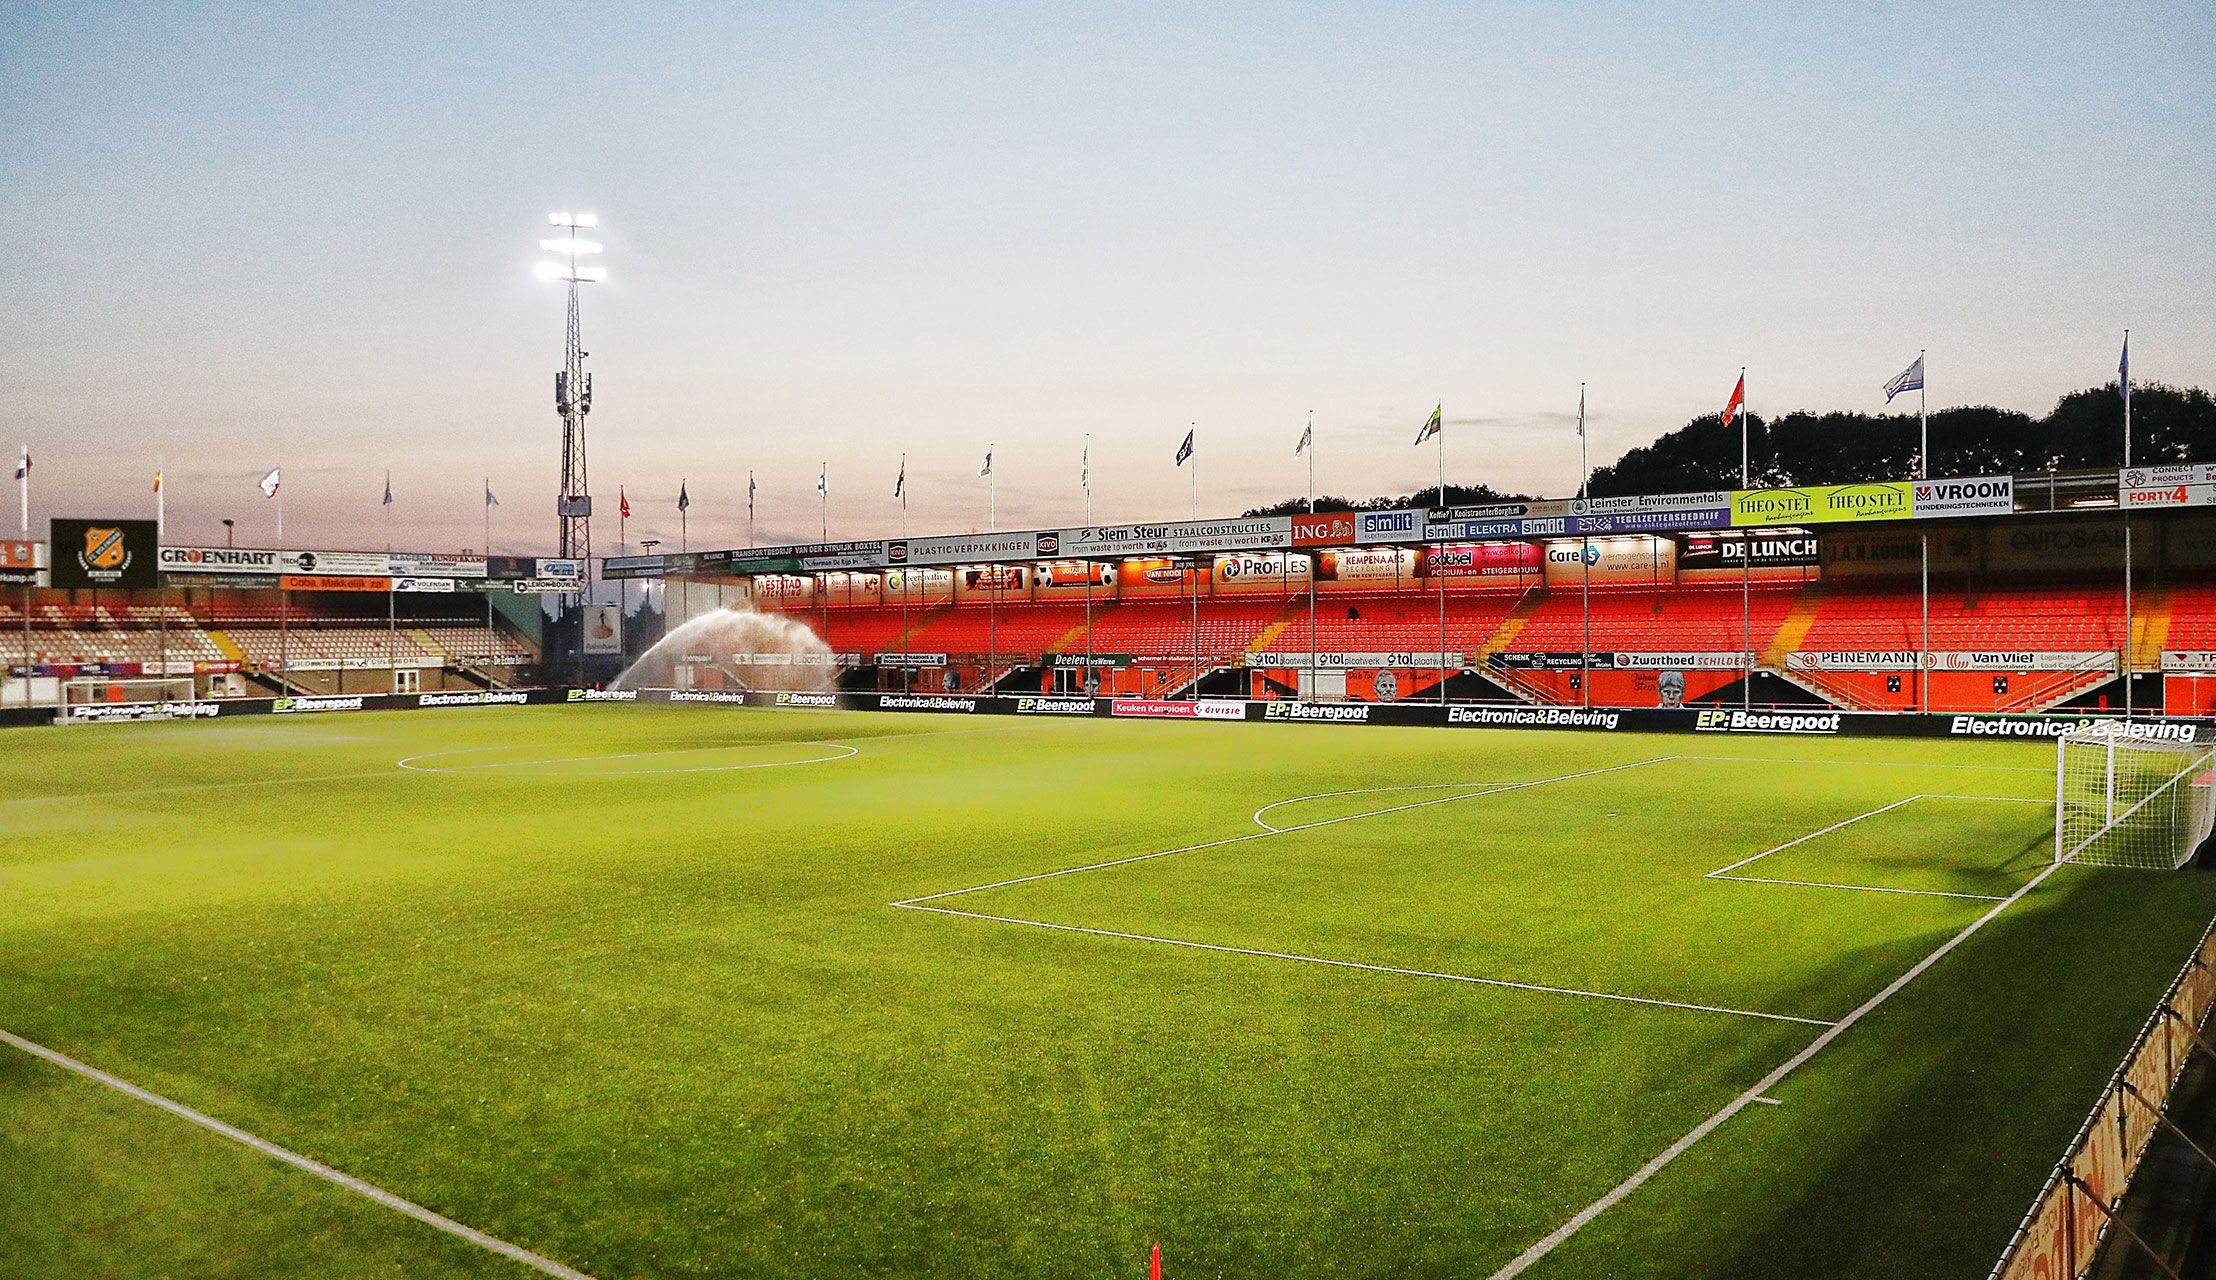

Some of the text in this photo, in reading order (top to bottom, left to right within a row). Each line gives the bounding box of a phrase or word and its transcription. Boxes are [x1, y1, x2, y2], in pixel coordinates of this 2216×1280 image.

[2152, 465, 2194, 474] CONNECT
[2152, 474, 2194, 482] PRODUCTS
[1936, 481, 2009, 500] VROOM
[1590, 492, 1724, 510] Leinster Environmentals
[1738, 498, 1812, 514] THEO STET
[1828, 492, 1905, 510] THEO STET
[1915, 500, 2010, 512] FUNDERINGSTECHNIEKEN
[1428, 508, 1450, 520] Koffie?
[1616, 511, 1720, 524] TEGELZETTERSBEDRIJF
[1366, 514, 1412, 532] smit
[1470, 524, 1518, 535] ELEKTRA
[1523, 518, 1566, 534] smit
[1098, 525, 1169, 541] Siem Steur
[1173, 523, 1272, 538] STAALCONSTRUCTIES
[1293, 524, 1329, 540] ING
[1427, 524, 1466, 539] smit
[810, 545, 823, 554] DER
[854, 541, 882, 550] BOXTEL
[1072, 545, 1089, 554] from
[1090, 543, 1112, 552] waste
[1112, 543, 1121, 552] to
[1122, 542, 1144, 551] worth
[1179, 538, 1198, 548] from
[1200, 538, 1223, 546] waste
[1224, 537, 1233, 546] to
[1234, 535, 1259, 545] worth
[914, 541, 1030, 556] PLASTIC VERPAKKINGEN
[1722, 542, 1745, 558] DE
[1751, 540, 1818, 556] LUNCH
[161, 550, 276, 565] GROENHART
[1548, 550, 1579, 562] Care
[1346, 565, 1390, 573] RECYCLING
[1482, 566, 1539, 575] STEIGERBOUW
[758, 578, 802, 592] WESTSTAD
[1055, 654, 1085, 666] Deelen
[1264, 653, 1279, 664] tol
[1329, 653, 1344, 664] tol
[1397, 653, 1413, 664] tol
[1546, 658, 1582, 666] RECYCLING
[1632, 655, 1694, 666] Zwarthoed
[1822, 652, 1918, 663] PEINEMANN
[1972, 653, 2034, 663] Van Vliet
[419, 692, 528, 706] Electronica&Beleving
[568, 688, 637, 700] EP:Beerepoot
[670, 692, 744, 704] Electronica&Beleving
[776, 692, 836, 706] EP:Beerepoot
[273, 698, 363, 710] EP:Beerepoot
[880, 696, 976, 712] Electronica&Beleving
[1018, 698, 1096, 712] EP:Beerepoot
[1116, 704, 1190, 714] Keuken Kampioen
[1204, 706, 1241, 715] divisie
[1266, 702, 1370, 720] EP:Beerepoot
[1448, 707, 1619, 730] Electronica&Beleving
[1696, 710, 1840, 731] EP:Beerepoot
[1950, 716, 2197, 743] Electronica&Beleving
